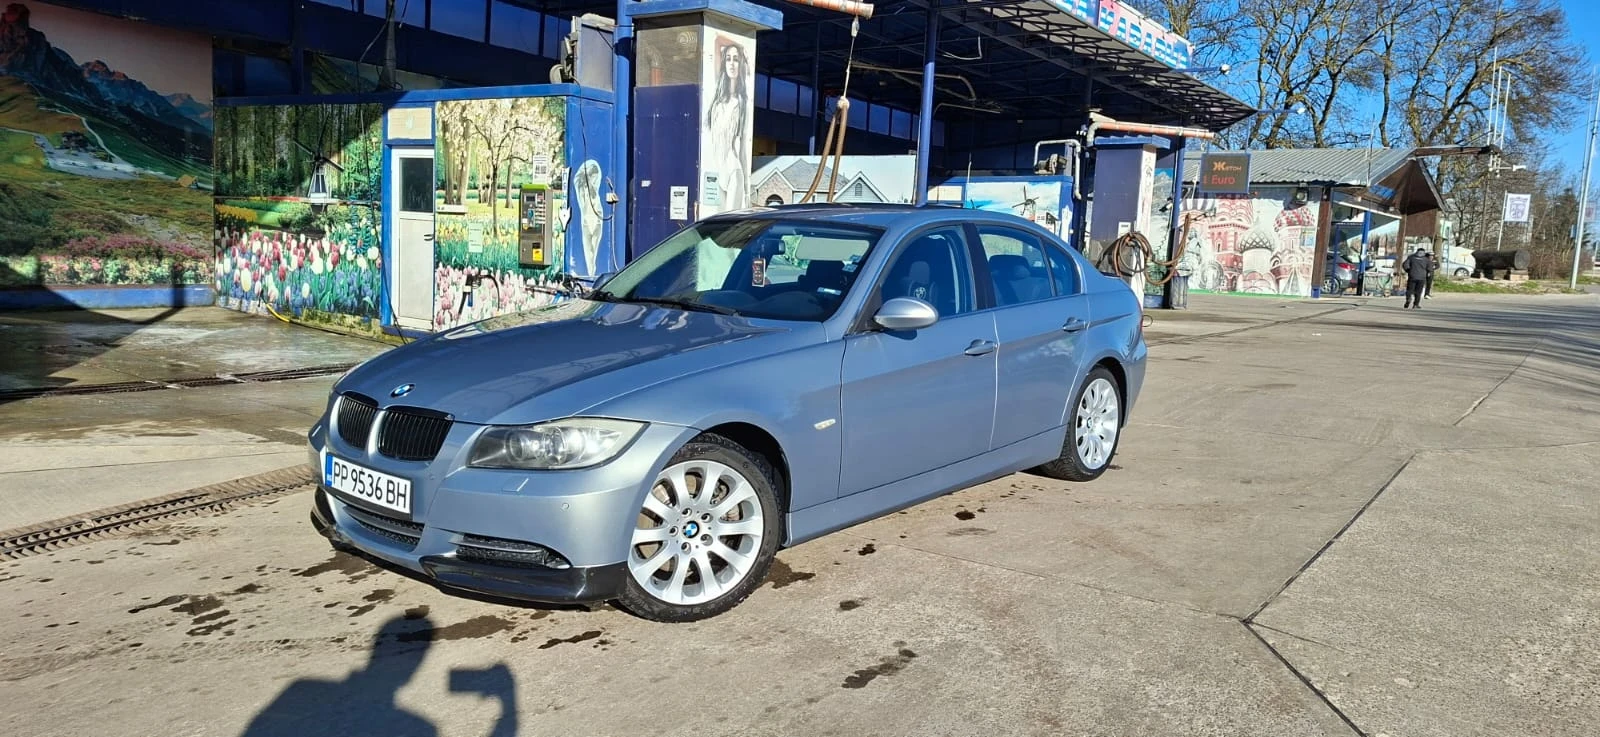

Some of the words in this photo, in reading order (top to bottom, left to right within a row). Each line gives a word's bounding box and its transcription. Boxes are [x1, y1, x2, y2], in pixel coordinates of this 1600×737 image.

[1211, 175, 1235, 184] Euro
[334, 462, 348, 487] PP
[351, 469, 383, 500] 9536
[386, 480, 407, 508] BH
